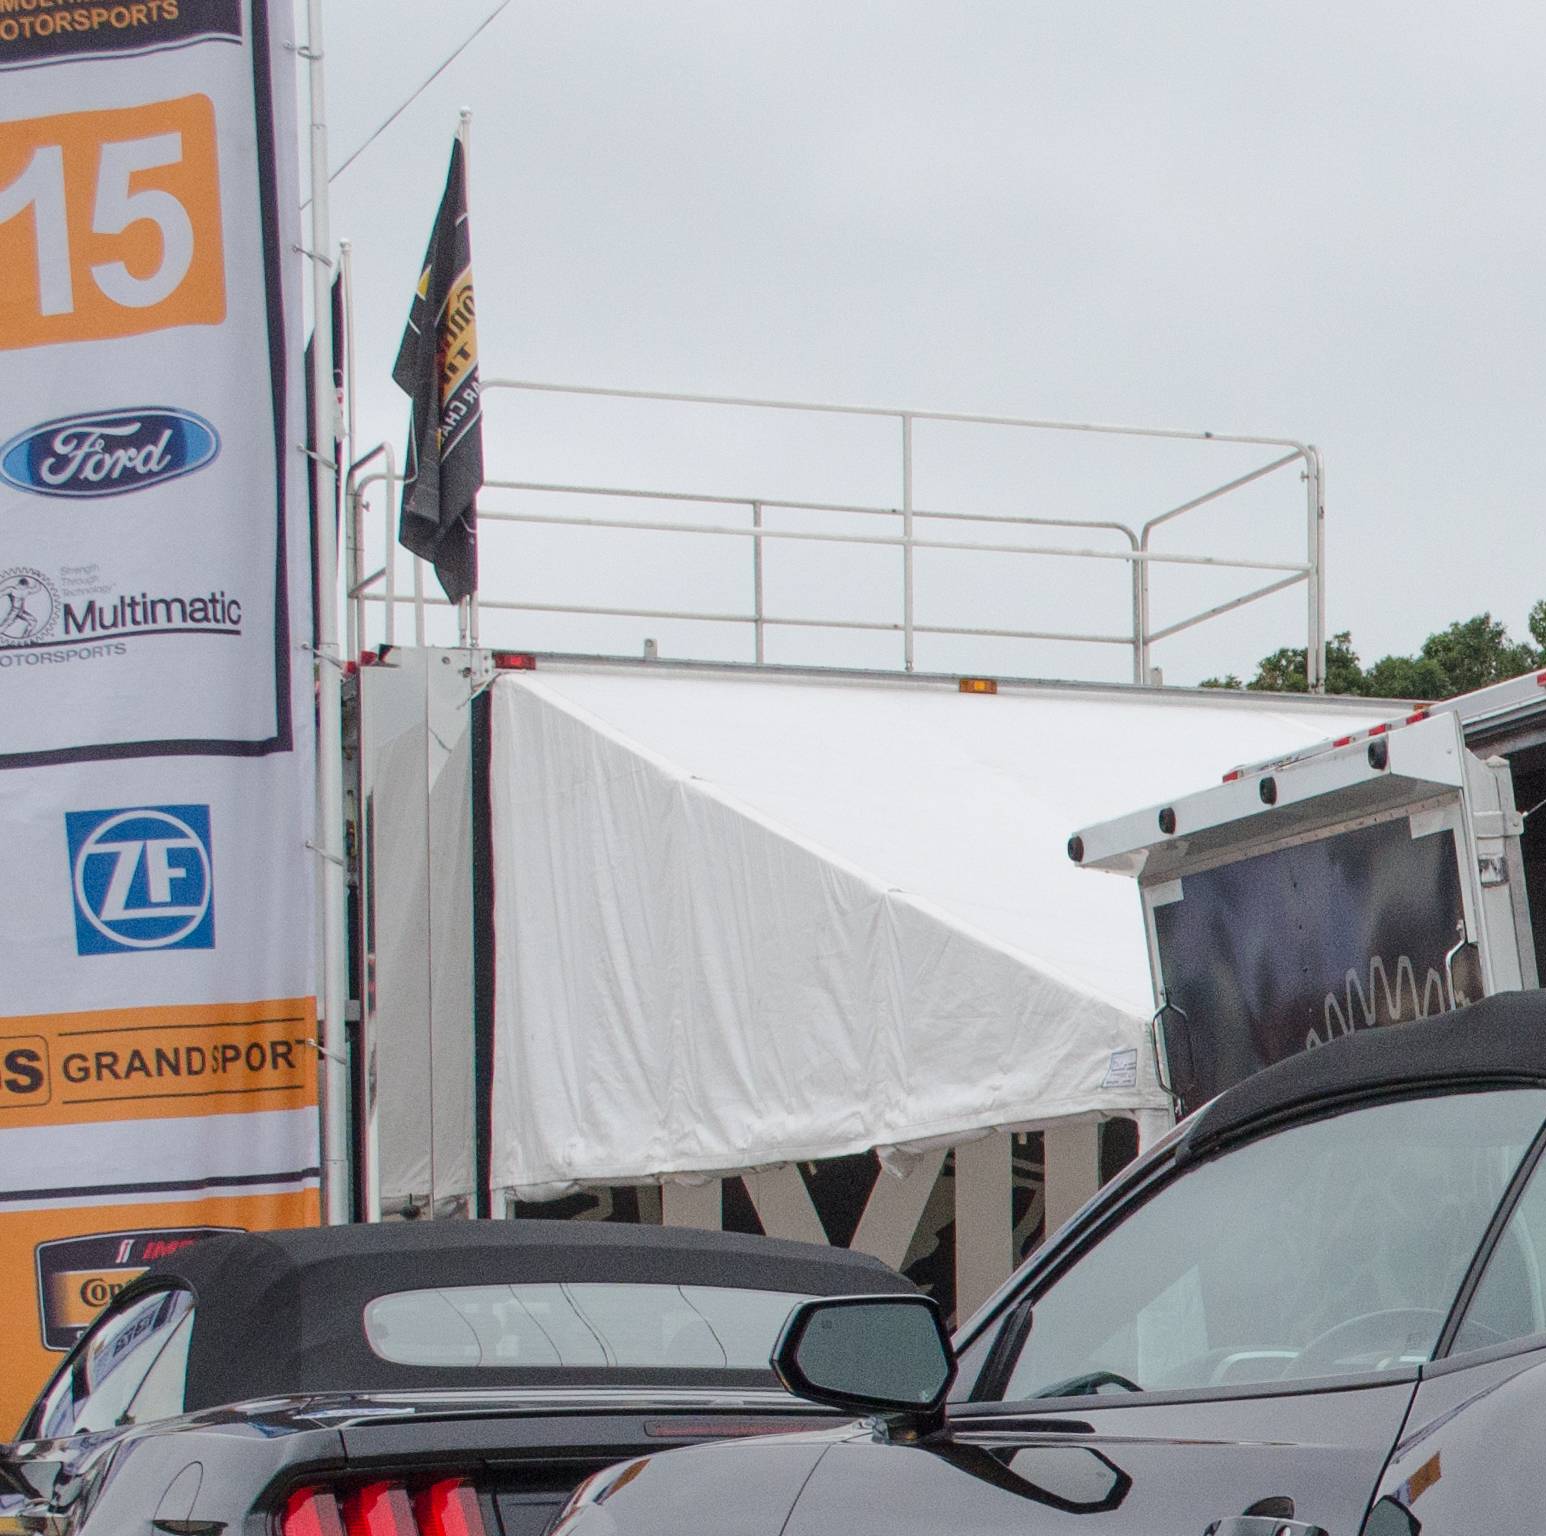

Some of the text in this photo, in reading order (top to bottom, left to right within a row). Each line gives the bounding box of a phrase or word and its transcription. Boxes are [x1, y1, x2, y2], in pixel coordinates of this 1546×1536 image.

[0, 132, 195, 317] 15
[41, 421, 172, 485] Ford
[63, 590, 242, 634] Multimatic
[82, 838, 202, 921] ZF
